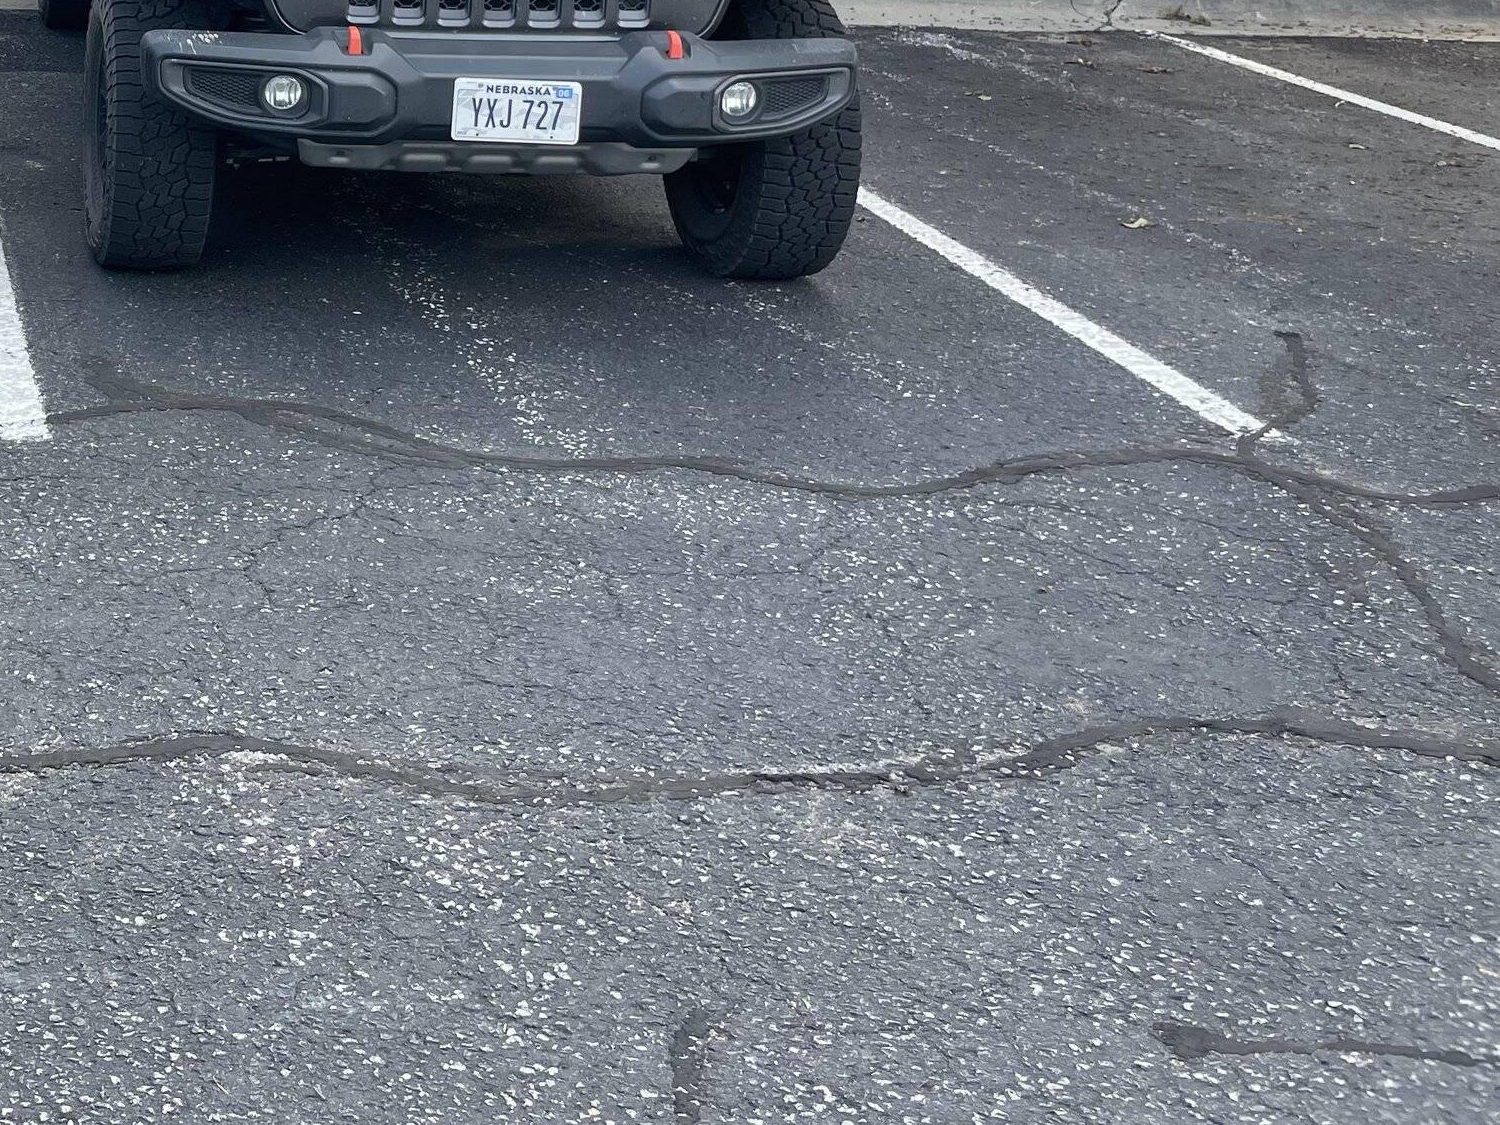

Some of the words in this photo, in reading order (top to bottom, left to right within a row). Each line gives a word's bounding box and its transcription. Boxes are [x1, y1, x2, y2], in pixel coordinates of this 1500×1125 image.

[486, 84, 551, 96] NEBRASKA
[471, 97, 513, 128] YXJ
[522, 99, 564, 131] 727
